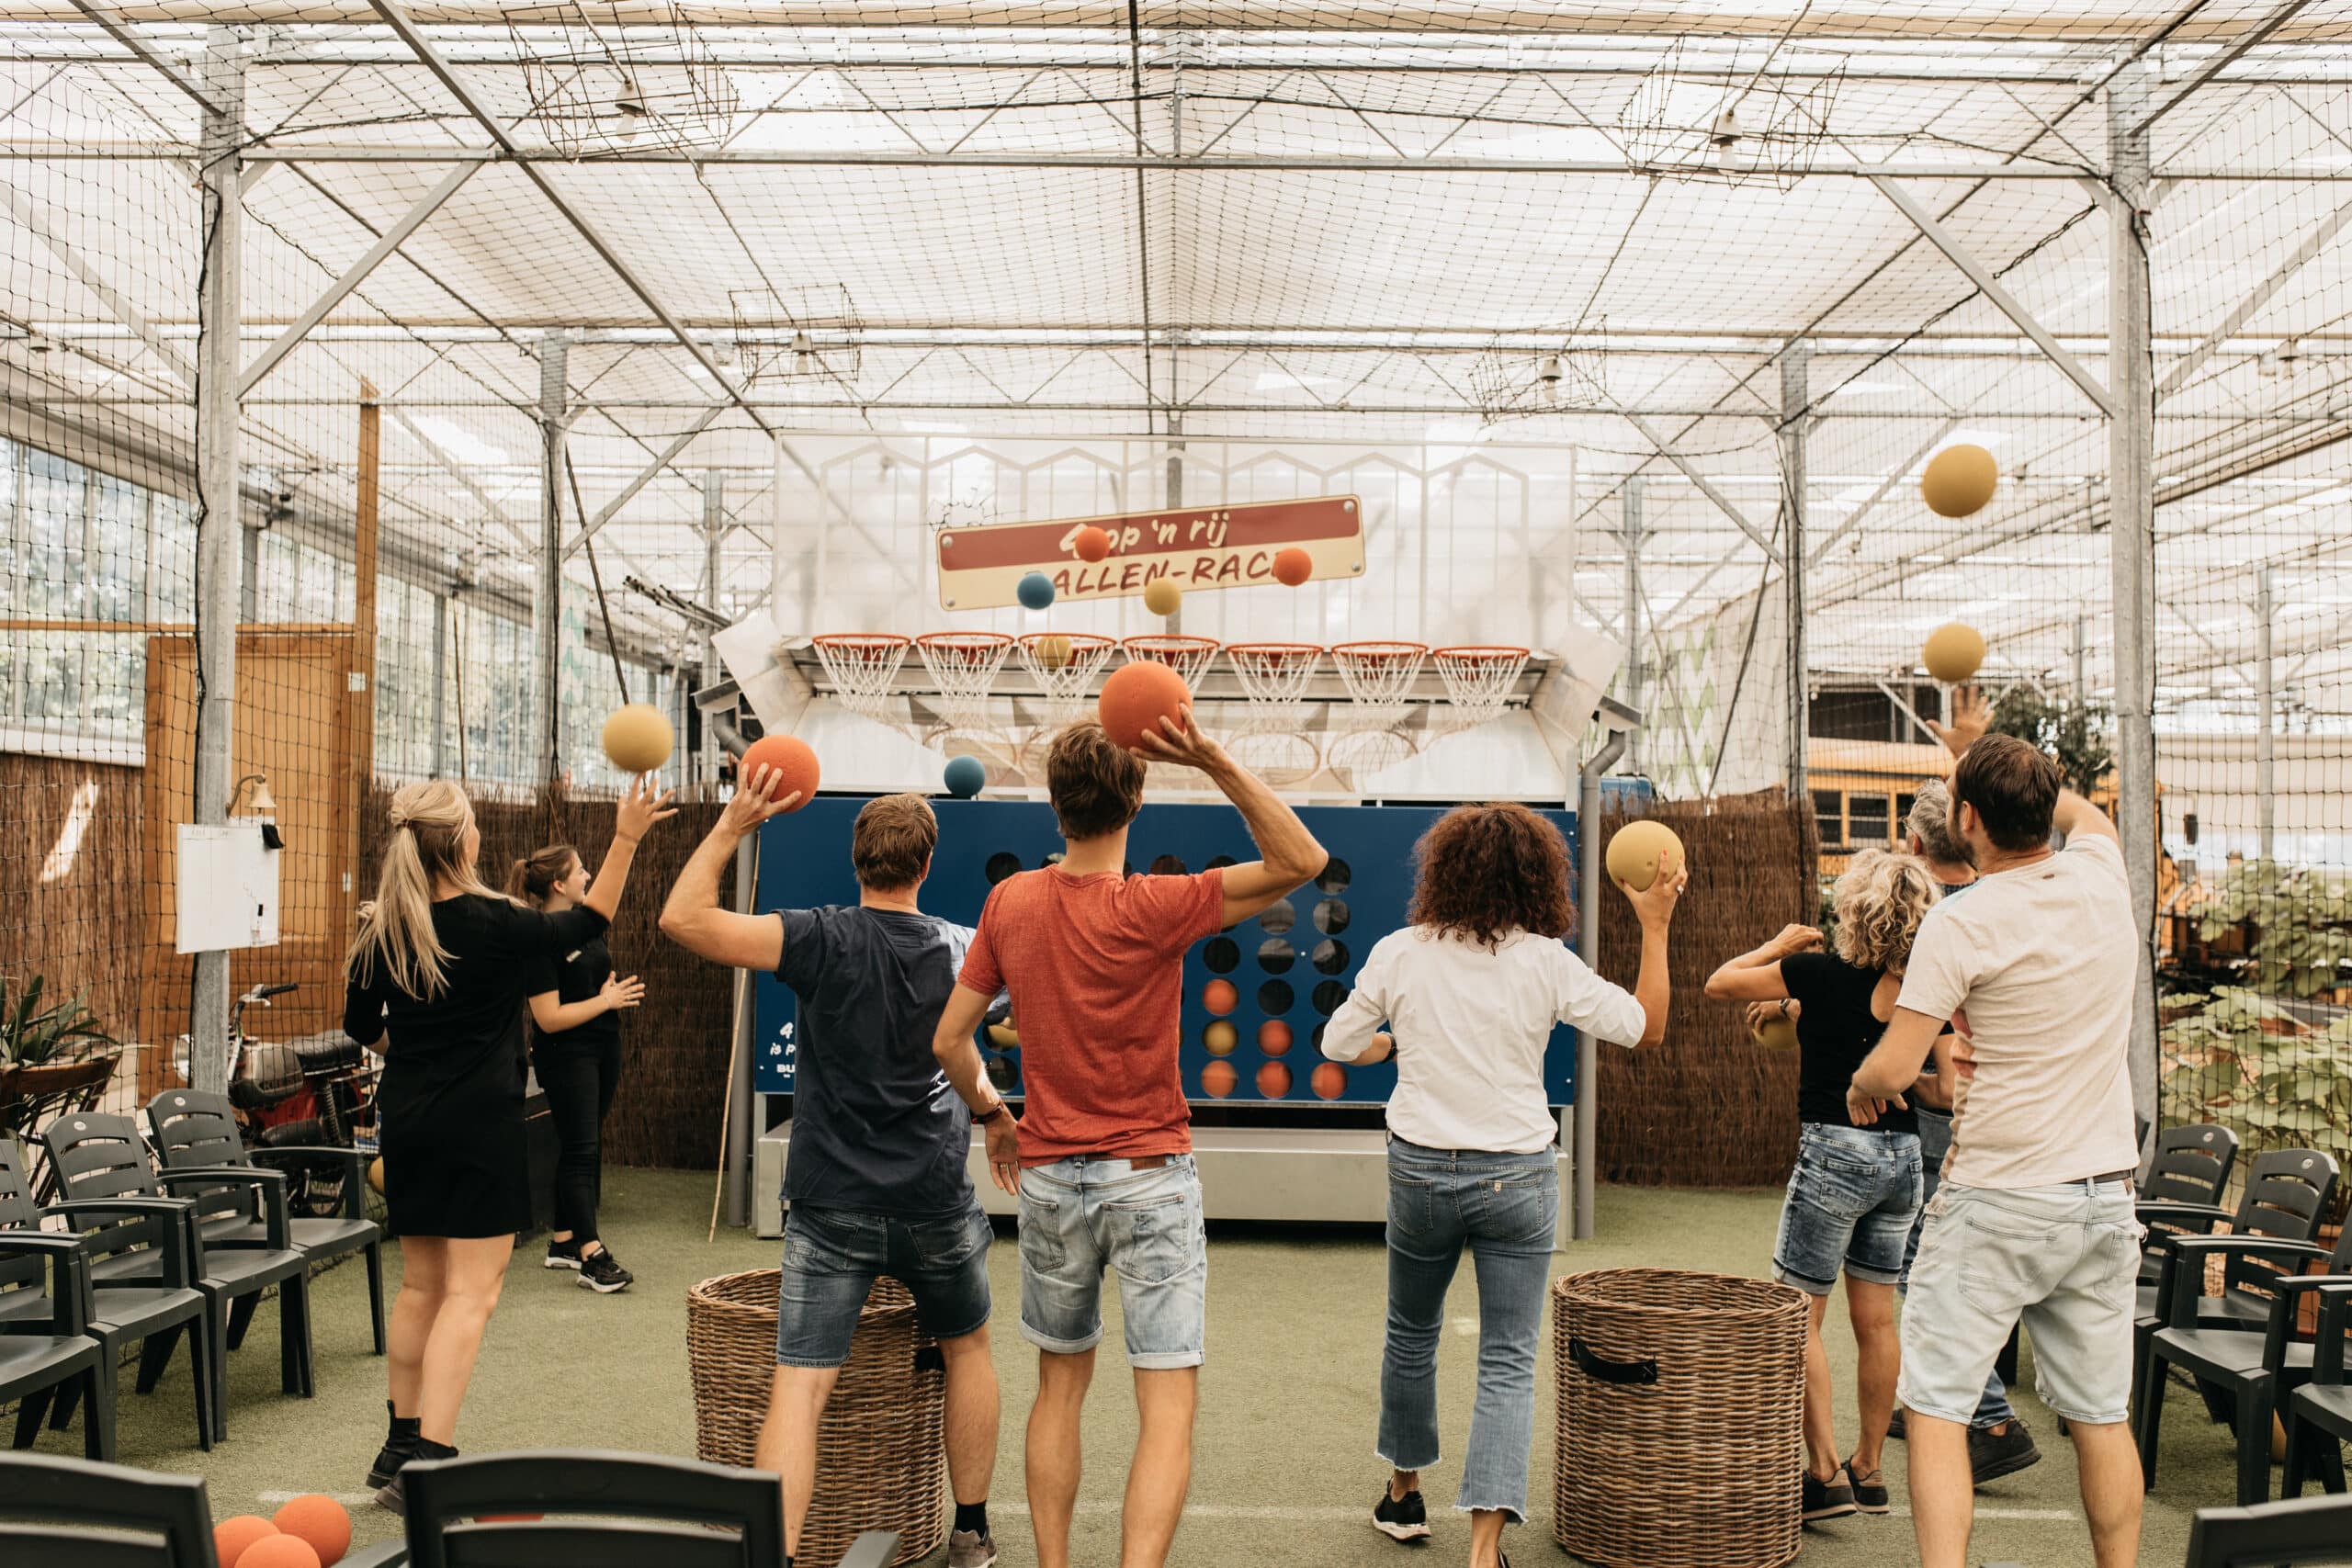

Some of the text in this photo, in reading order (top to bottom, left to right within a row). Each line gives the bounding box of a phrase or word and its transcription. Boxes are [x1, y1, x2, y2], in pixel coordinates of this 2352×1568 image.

[1189, 512, 1230, 547] rij
[1023, 550, 1277, 597] ALLEN-RAC
[776, 1064, 796, 1073] BU
